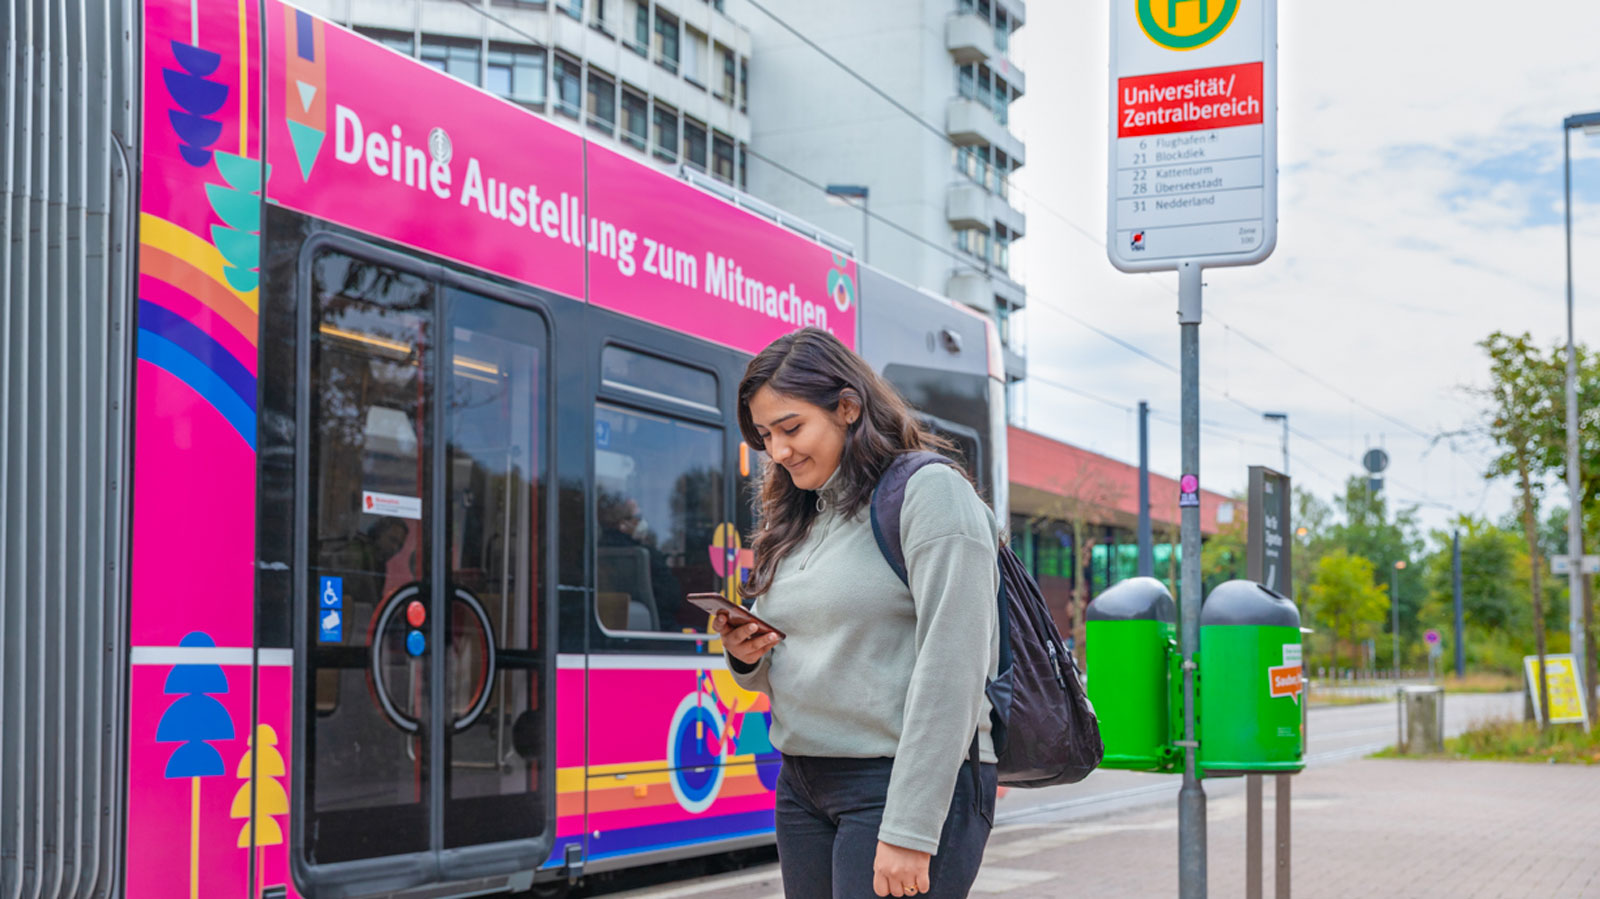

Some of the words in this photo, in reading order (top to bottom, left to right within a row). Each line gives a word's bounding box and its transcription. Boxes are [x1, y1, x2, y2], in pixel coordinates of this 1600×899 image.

[1124, 74, 1236, 106] Universität/
[1123, 96, 1260, 128] Zentralbereich
[1139, 140, 1147, 150] 6
[1156, 135, 1206, 148] Flughafen
[1133, 153, 1147, 164] 21
[1156, 148, 1205, 162] Blockdiek
[1133, 169, 1147, 181] 22
[1156, 166, 1213, 178] Kattenturm
[1133, 183, 1147, 195] 28
[1155, 178, 1223, 193] Überseestadt
[335, 103, 452, 199] Deine
[460, 157, 637, 277] Austellung
[643, 237, 698, 289] zum
[1133, 201, 1146, 212] 31
[1156, 195, 1215, 210] Nedderland
